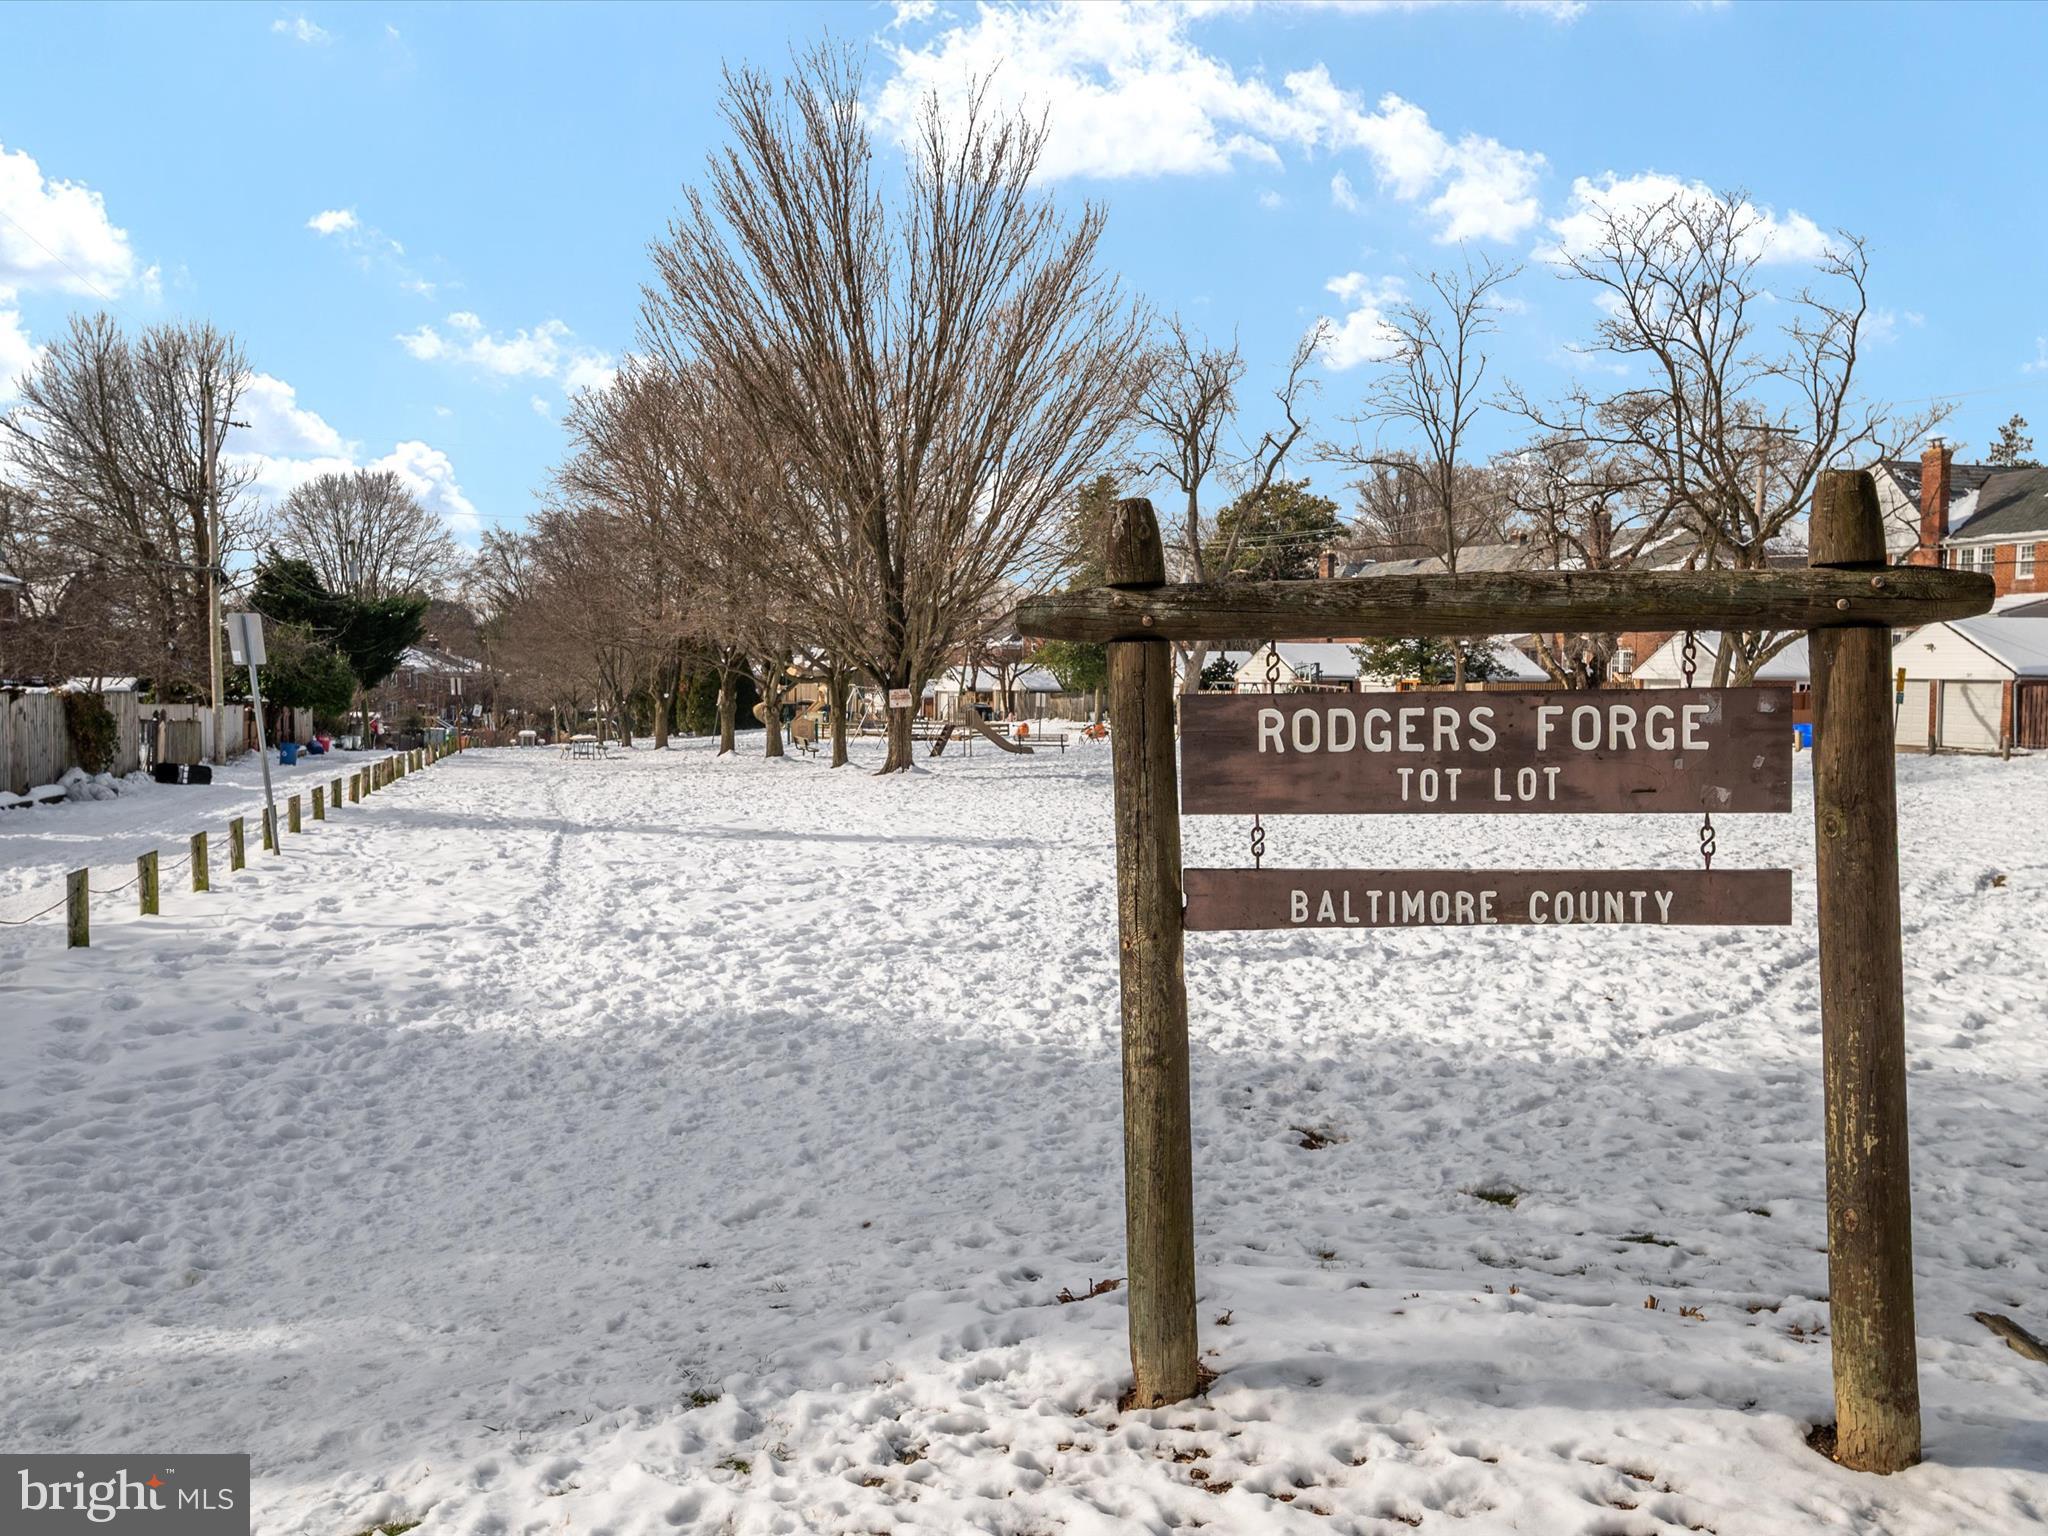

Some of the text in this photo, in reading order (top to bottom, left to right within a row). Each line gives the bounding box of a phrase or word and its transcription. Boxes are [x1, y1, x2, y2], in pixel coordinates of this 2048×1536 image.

[1258, 704, 1710, 753] RODGERS FORGE
[1396, 766, 1561, 803] TOT LOT
[1290, 889, 1674, 924] BALTIMORE COUNTY
